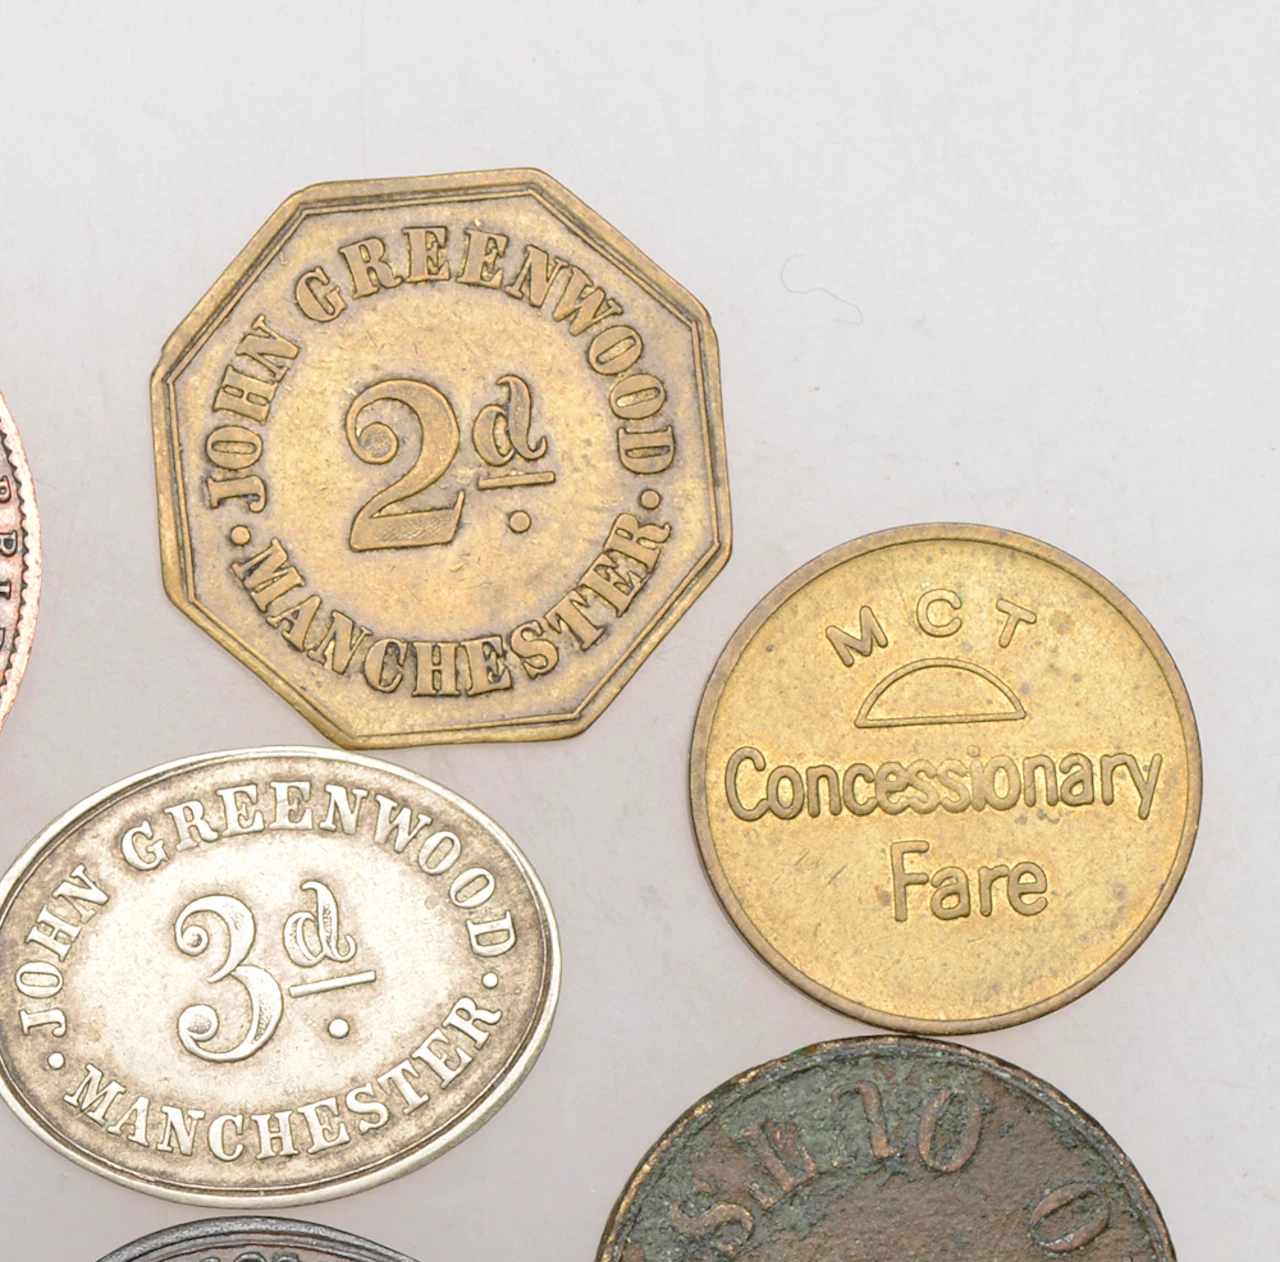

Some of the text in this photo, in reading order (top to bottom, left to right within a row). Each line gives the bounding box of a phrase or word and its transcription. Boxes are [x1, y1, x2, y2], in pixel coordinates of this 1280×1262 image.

[204, 226, 677, 514] JOHN GREENWOOD
[229, 511, 672, 697] MANCHESTER
[725, 745, 1163, 822] Concessionary
[15, 780, 516, 1037] JOHN GREENWOOD
[890, 840, 1050, 921] Fare
[63, 996, 502, 1162] MANCHESTER
